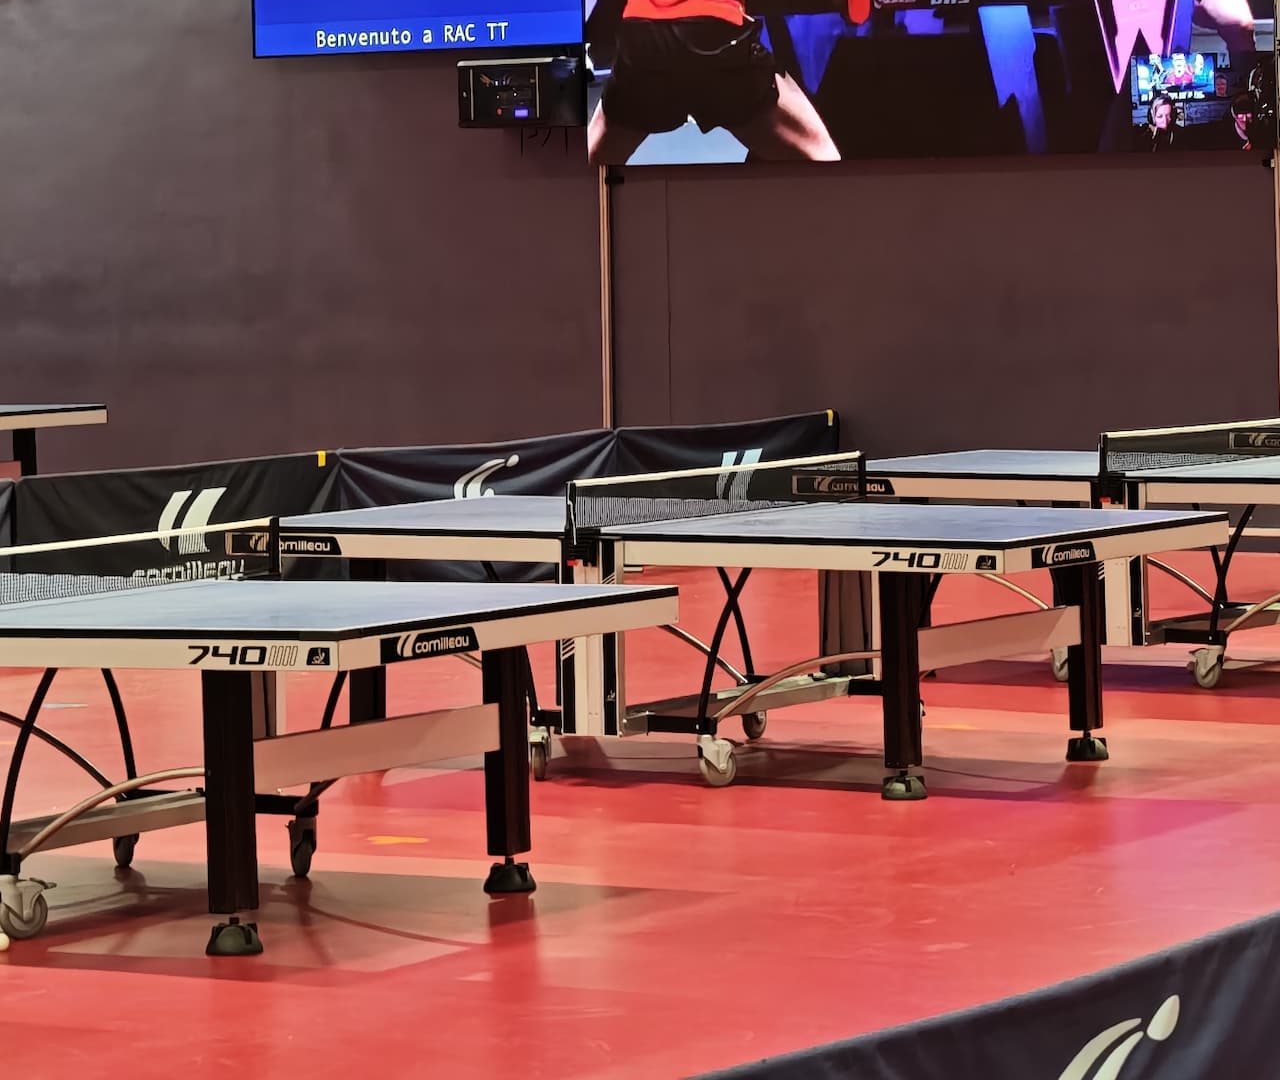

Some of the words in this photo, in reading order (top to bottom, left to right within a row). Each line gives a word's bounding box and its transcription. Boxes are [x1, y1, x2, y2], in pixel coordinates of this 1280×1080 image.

[316, 27, 412, 48] Benvenuto
[422, 28, 433, 44] a
[443, 23, 476, 43] RAC
[486, 22, 509, 41] TT
[872, 550, 941, 569] 740
[188, 645, 267, 665] 740
[415, 635, 470, 655] cornilleau
